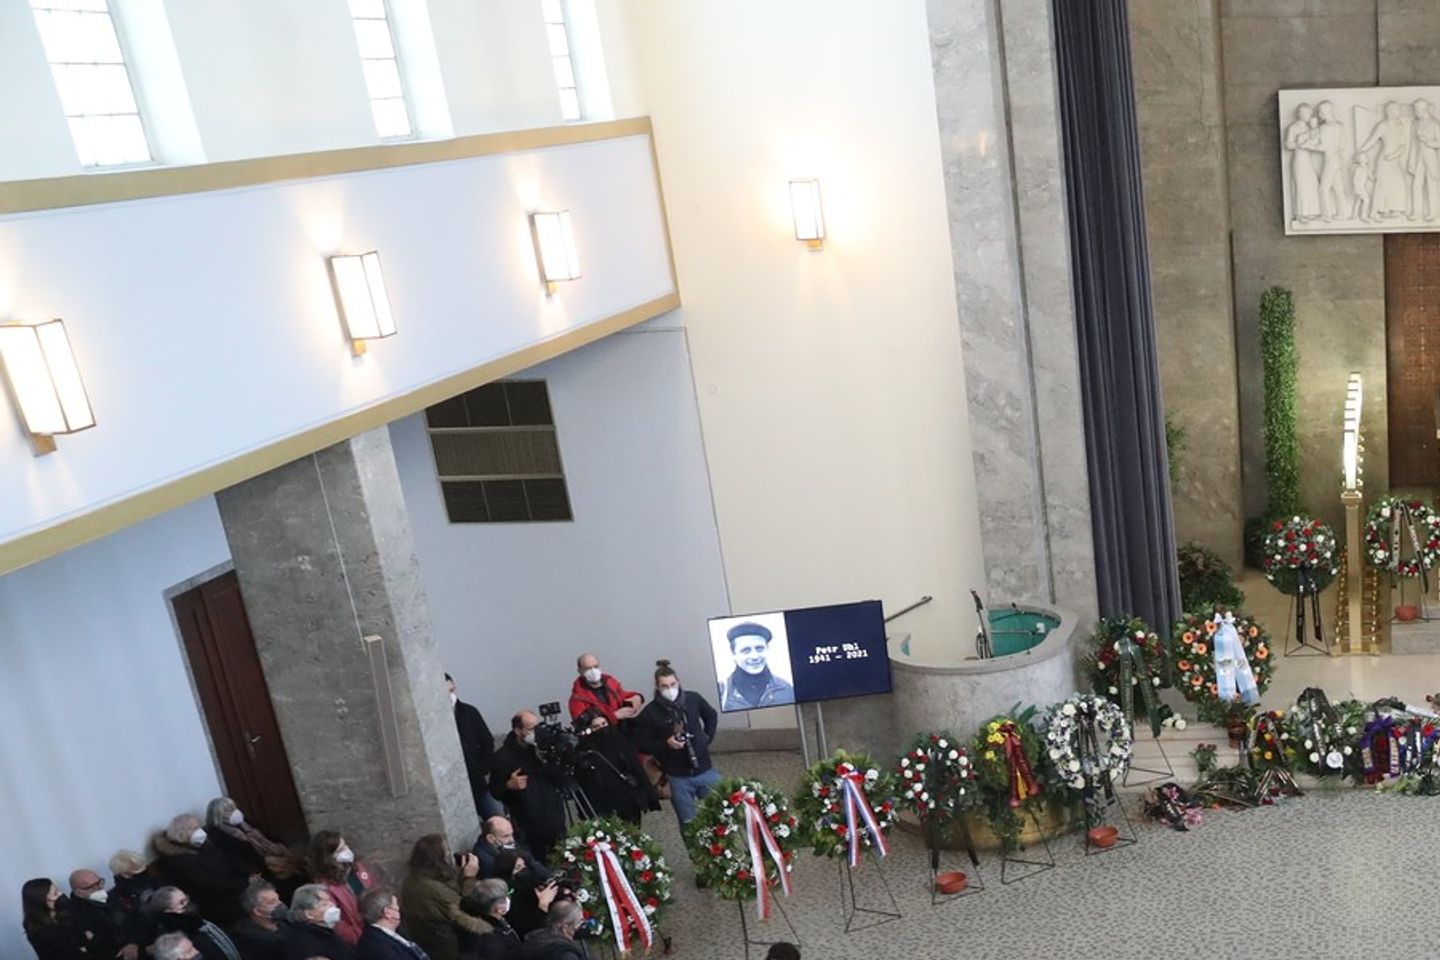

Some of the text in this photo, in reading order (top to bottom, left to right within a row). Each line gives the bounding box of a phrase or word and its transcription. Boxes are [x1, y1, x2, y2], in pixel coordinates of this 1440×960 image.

[815, 646, 838, 654] Petr
[809, 654, 831, 664] 1941
[846, 650, 868, 659] 2021
